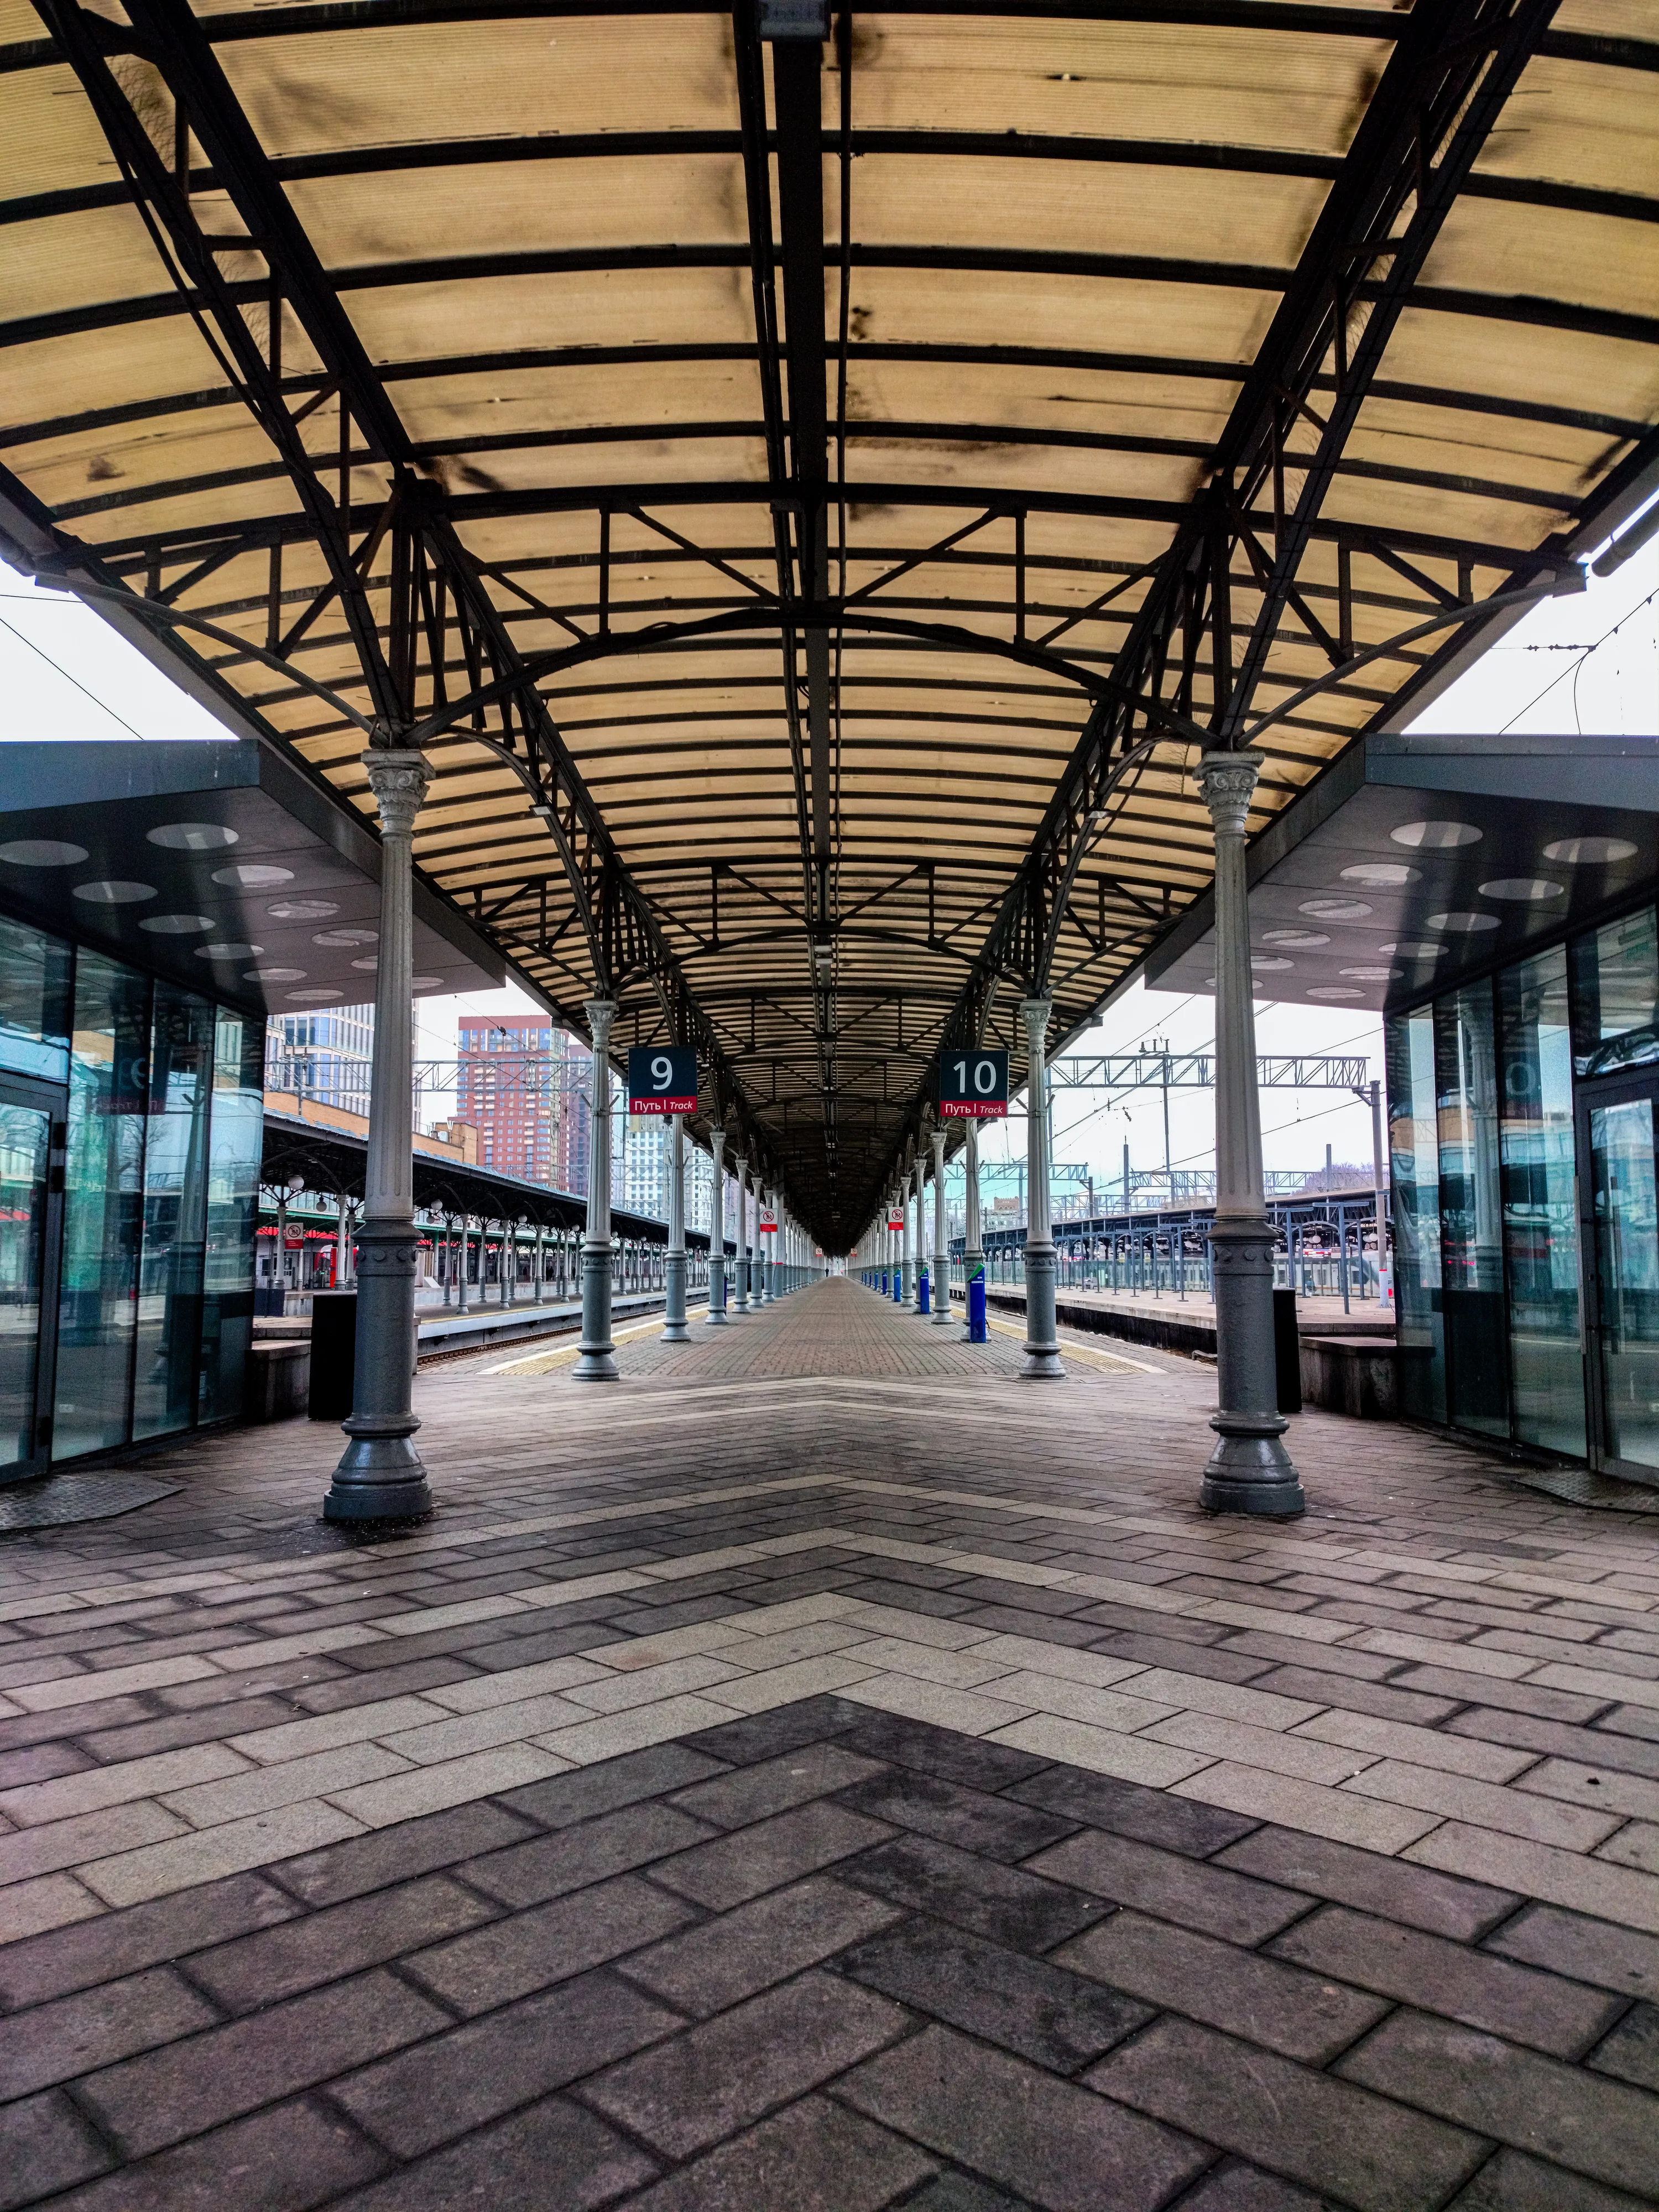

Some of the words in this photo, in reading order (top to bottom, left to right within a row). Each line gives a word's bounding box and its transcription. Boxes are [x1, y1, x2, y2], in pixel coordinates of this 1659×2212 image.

[651, 1056, 673, 1091] 9
[953, 1061, 997, 1093] 10
[634, 1100, 661, 1113] Путь
[670, 1100, 693, 1110] Track
[945, 1103, 972, 1116] Путь
[980, 1105, 1003, 1114] Track
